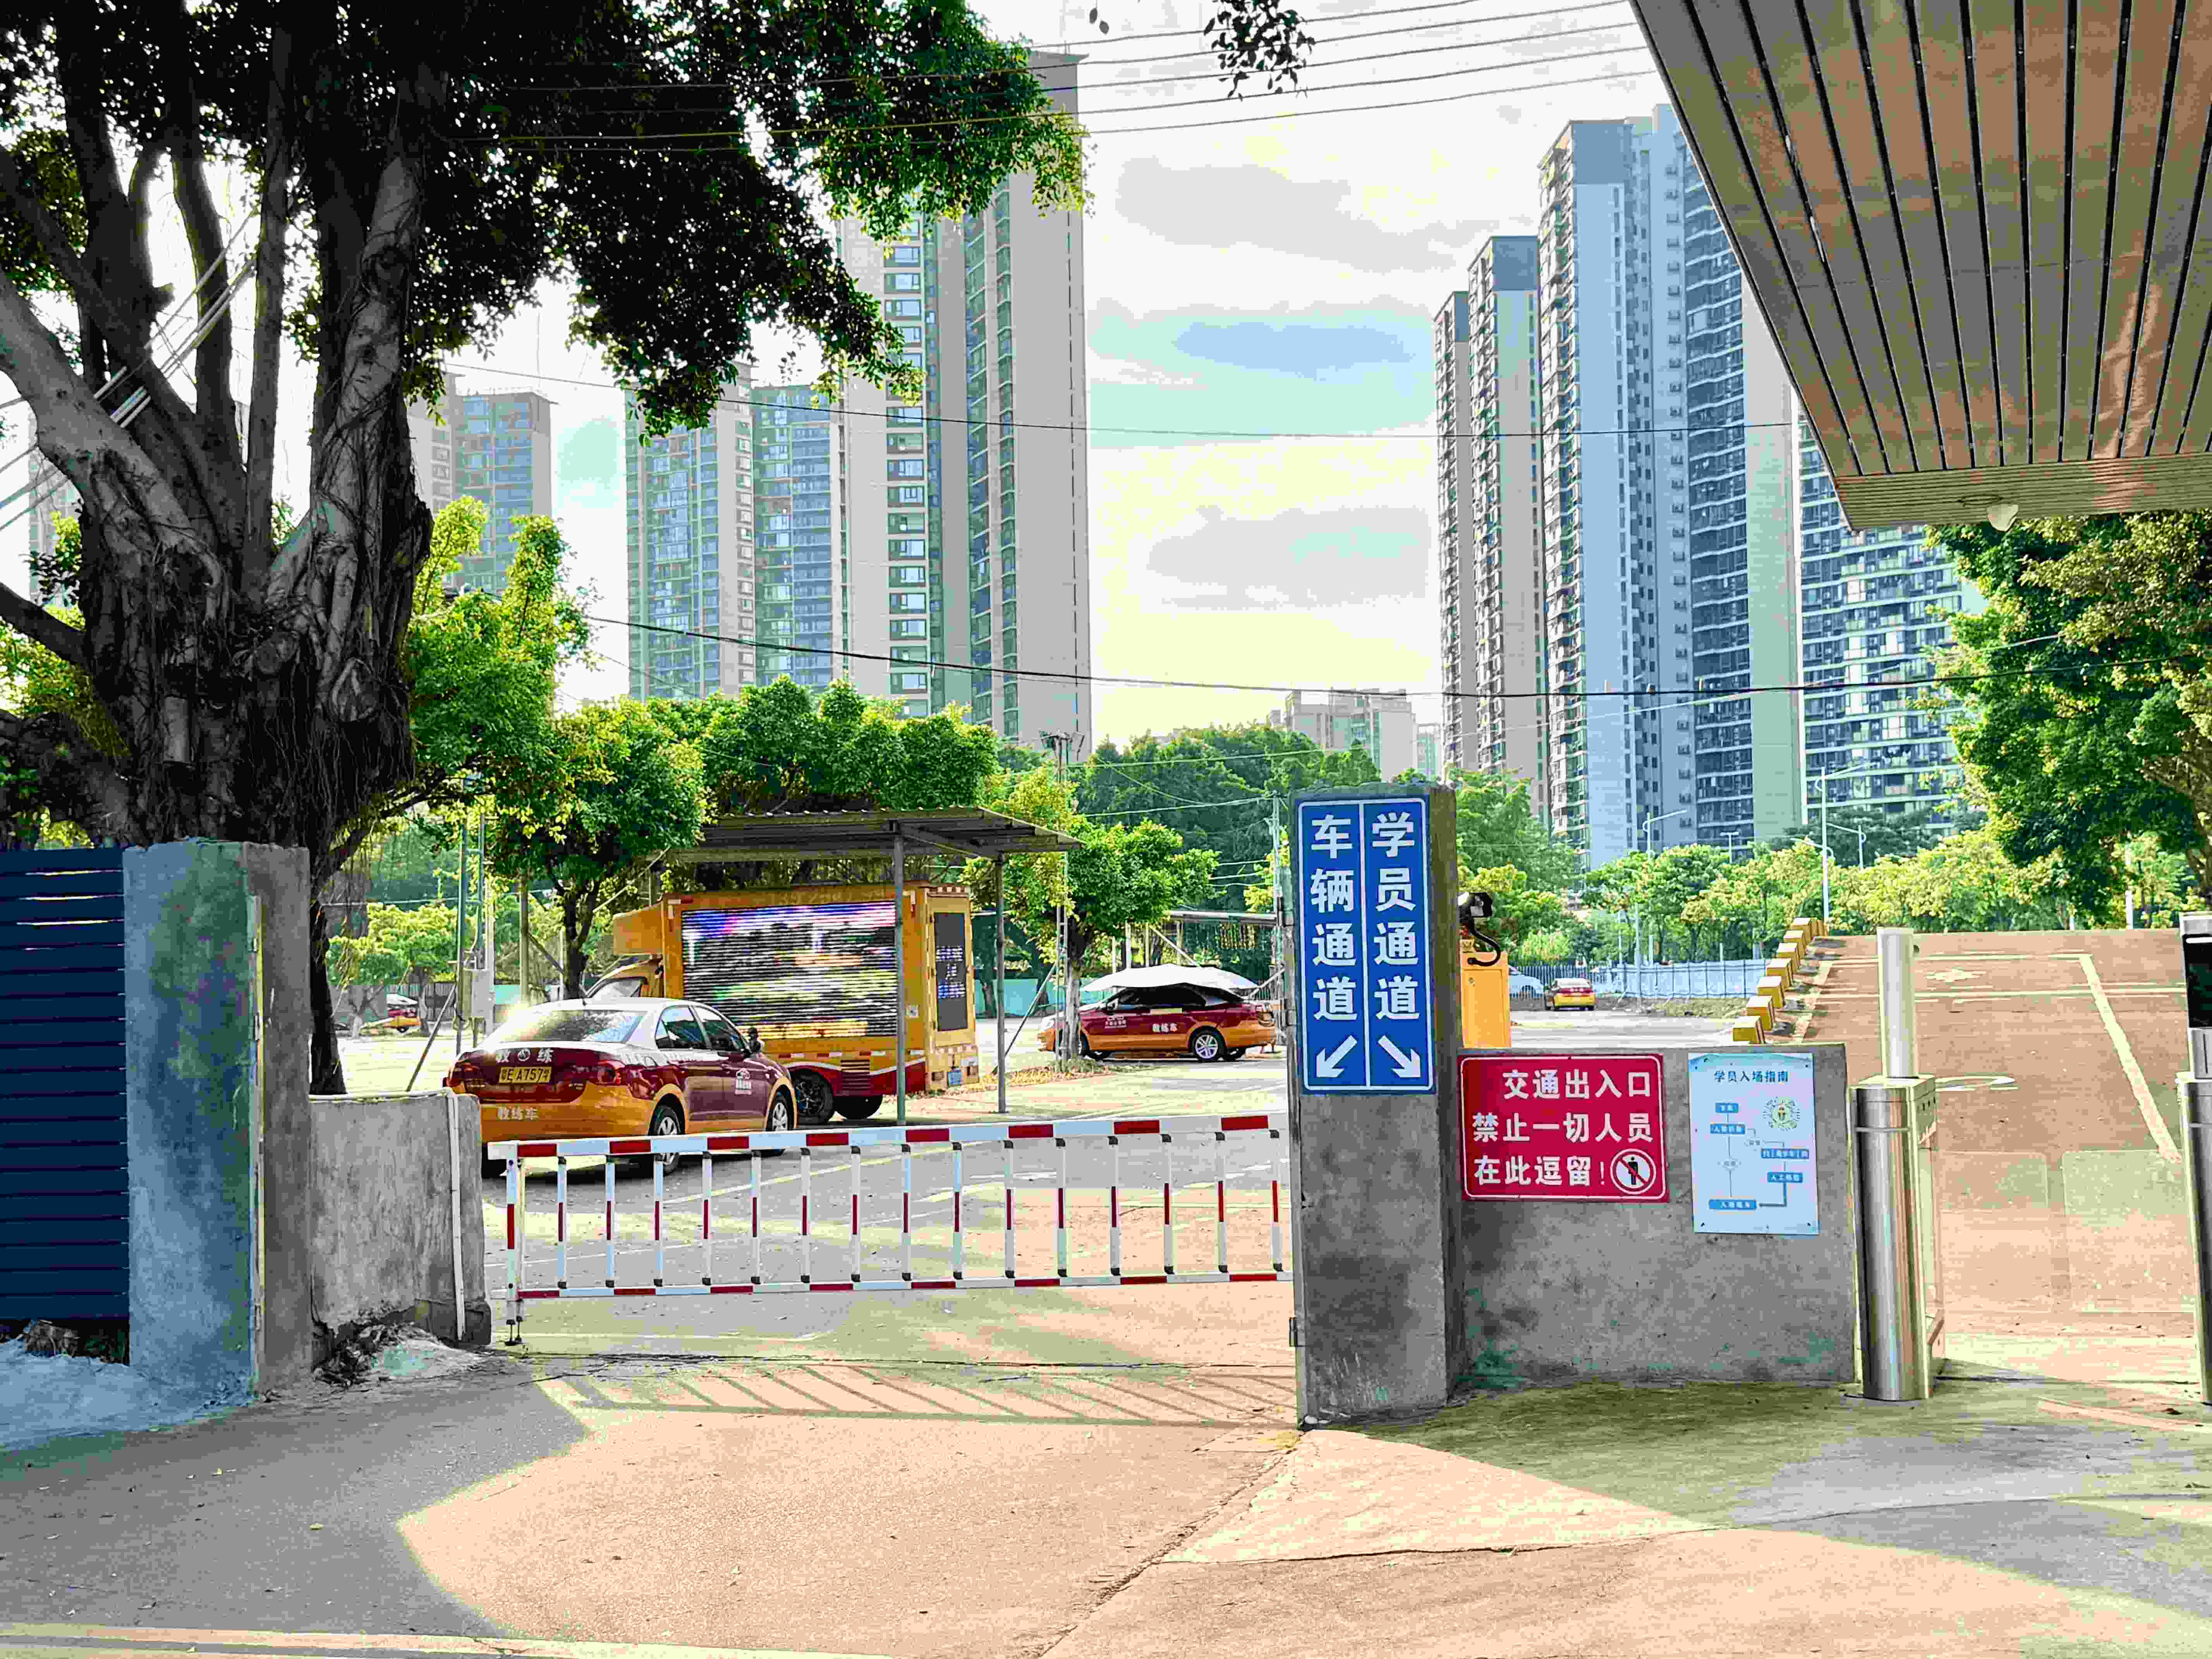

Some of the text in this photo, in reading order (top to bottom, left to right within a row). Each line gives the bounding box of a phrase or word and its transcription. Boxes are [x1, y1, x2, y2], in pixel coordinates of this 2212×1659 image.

[1310, 814, 1357, 1021] 车辆通道
[1371, 811, 1420, 1020] 学员通道
[1502, 1068, 1650, 1099] 交通出入口
[1714, 1070, 1788, 1082] 学员入场指南
[1472, 1112, 1653, 1143] 禁止一切人员
